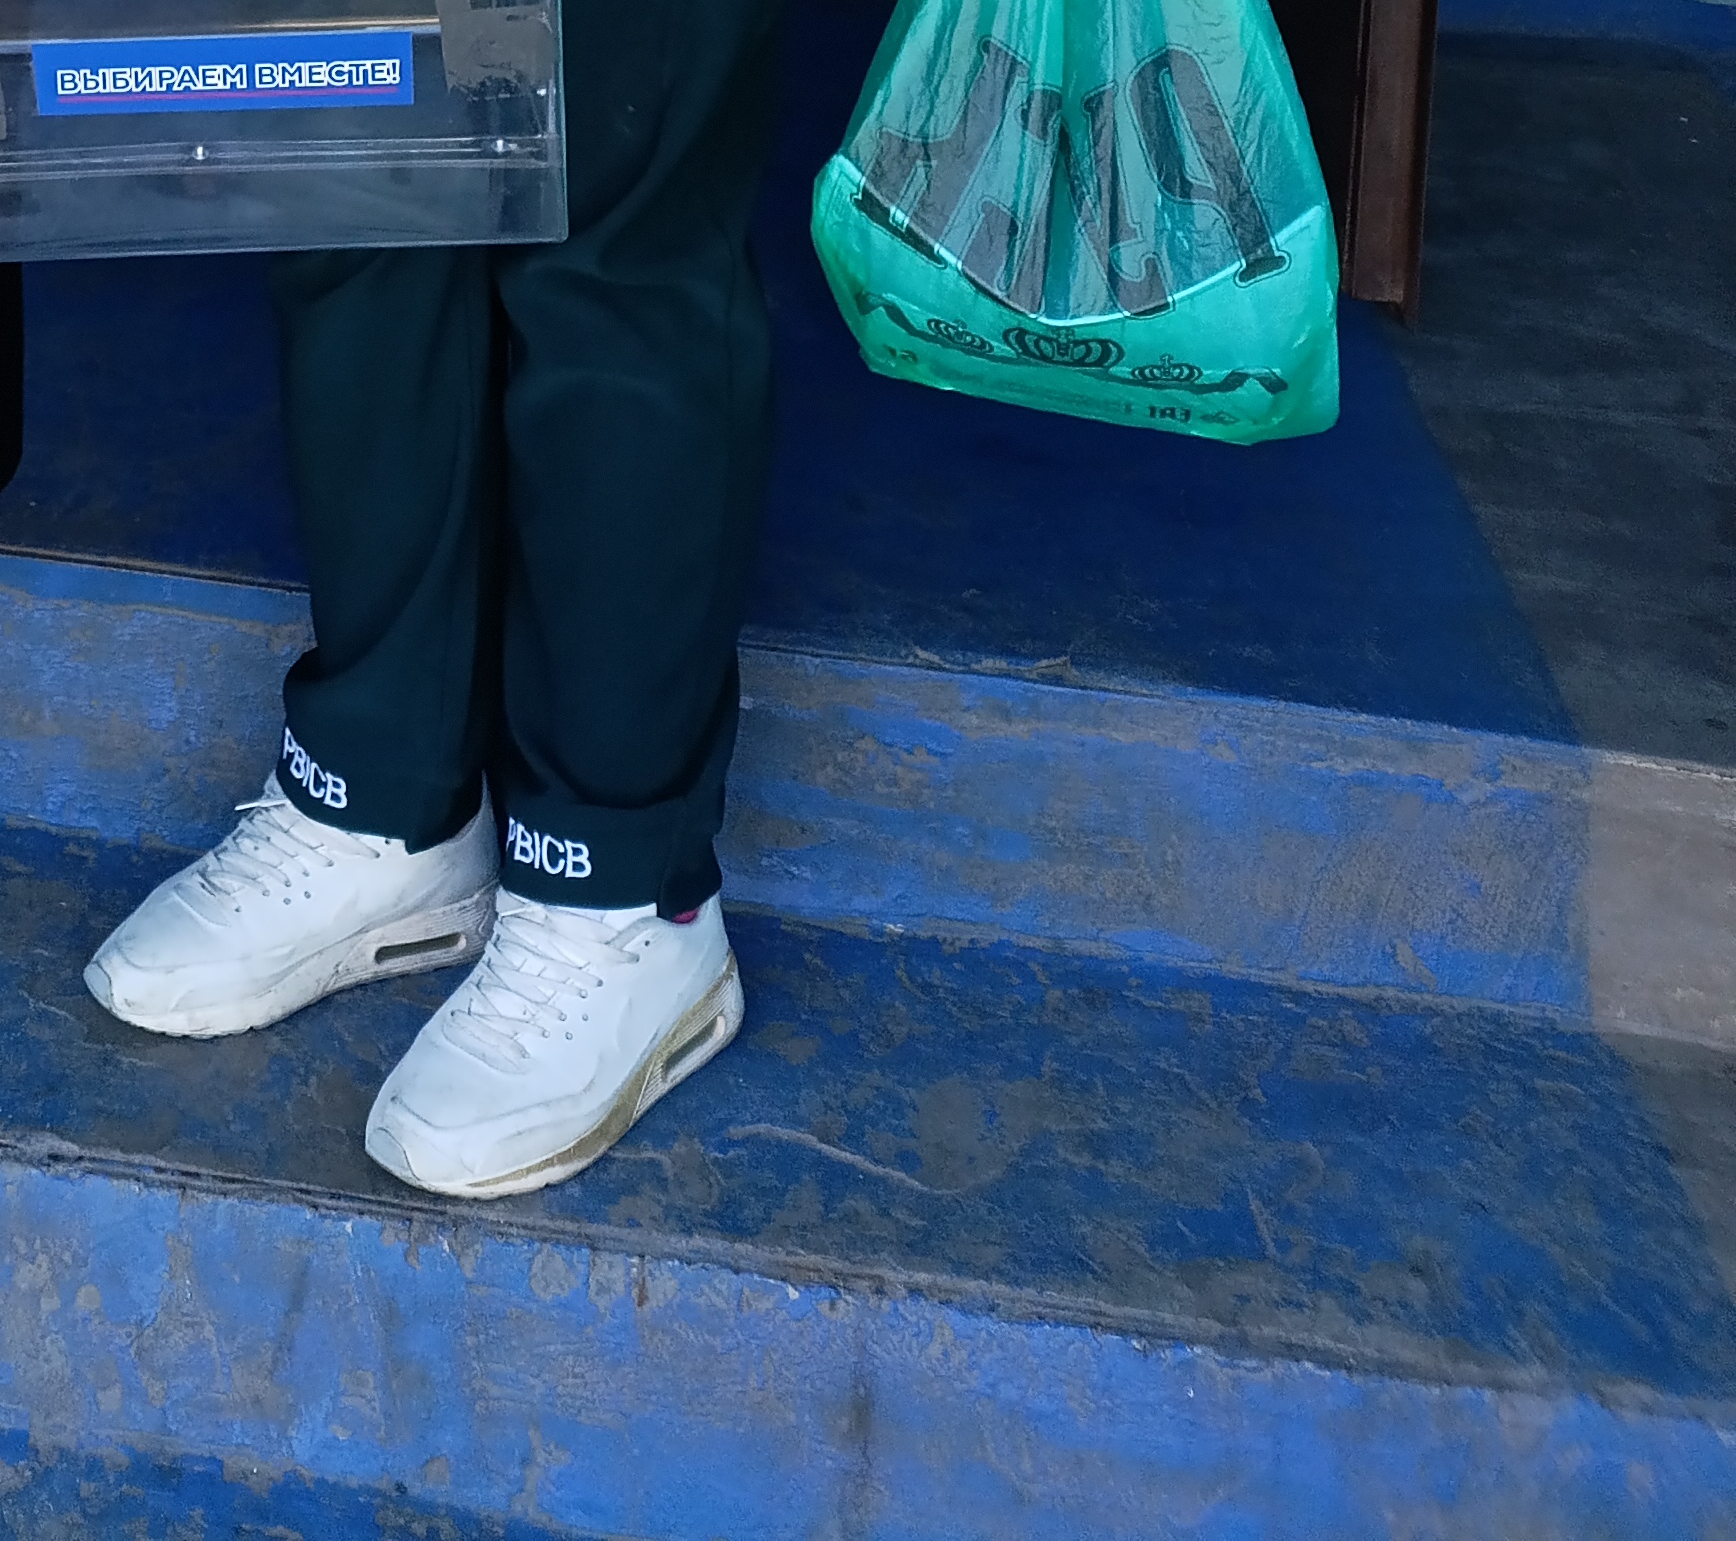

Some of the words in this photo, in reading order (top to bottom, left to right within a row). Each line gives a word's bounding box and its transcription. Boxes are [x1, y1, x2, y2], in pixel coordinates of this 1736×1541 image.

[57, 64, 248, 95] ВЫБИРАЕМ
[254, 59, 400, 90] ВМЕСТЕ!
[505, 817, 591, 878] PBICB
